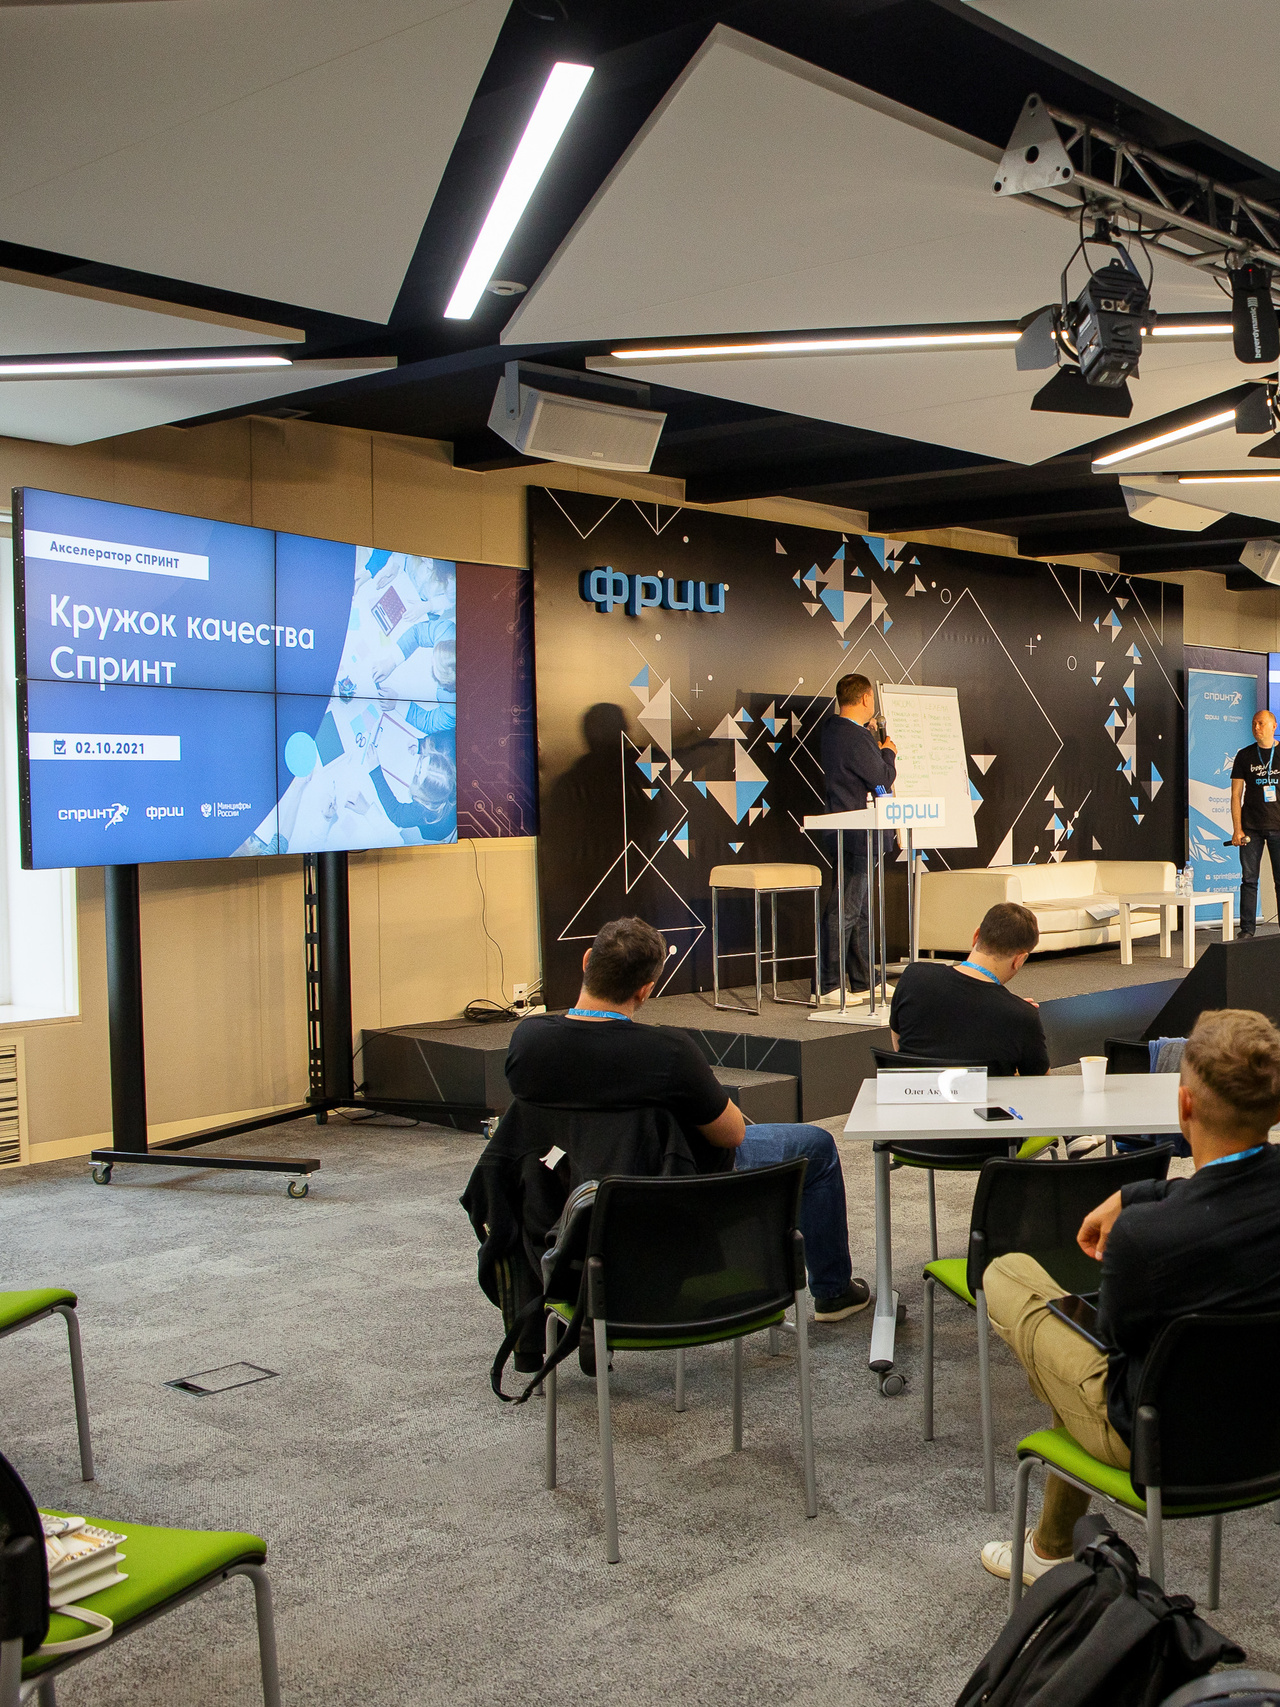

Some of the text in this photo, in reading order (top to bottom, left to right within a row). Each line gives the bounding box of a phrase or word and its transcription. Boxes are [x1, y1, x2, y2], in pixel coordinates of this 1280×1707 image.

[1250, 307, 1261, 358] beyerdynamic
[50, 540, 180, 569] Акселератор СПРИНТ
[589, 566, 725, 616] фрии
[50, 594, 315, 650] Кружок качества
[50, 646, 176, 691] Спринт
[1204, 692, 1236, 702] спринт
[75, 742, 145, 754] 02.10.2021
[58, 805, 184, 822] спринт фрии
[886, 802, 939, 824] фрии
[1213, 873, 1240, 881] sprint@iidf
[904, 1088, 925, 1096] Олег
